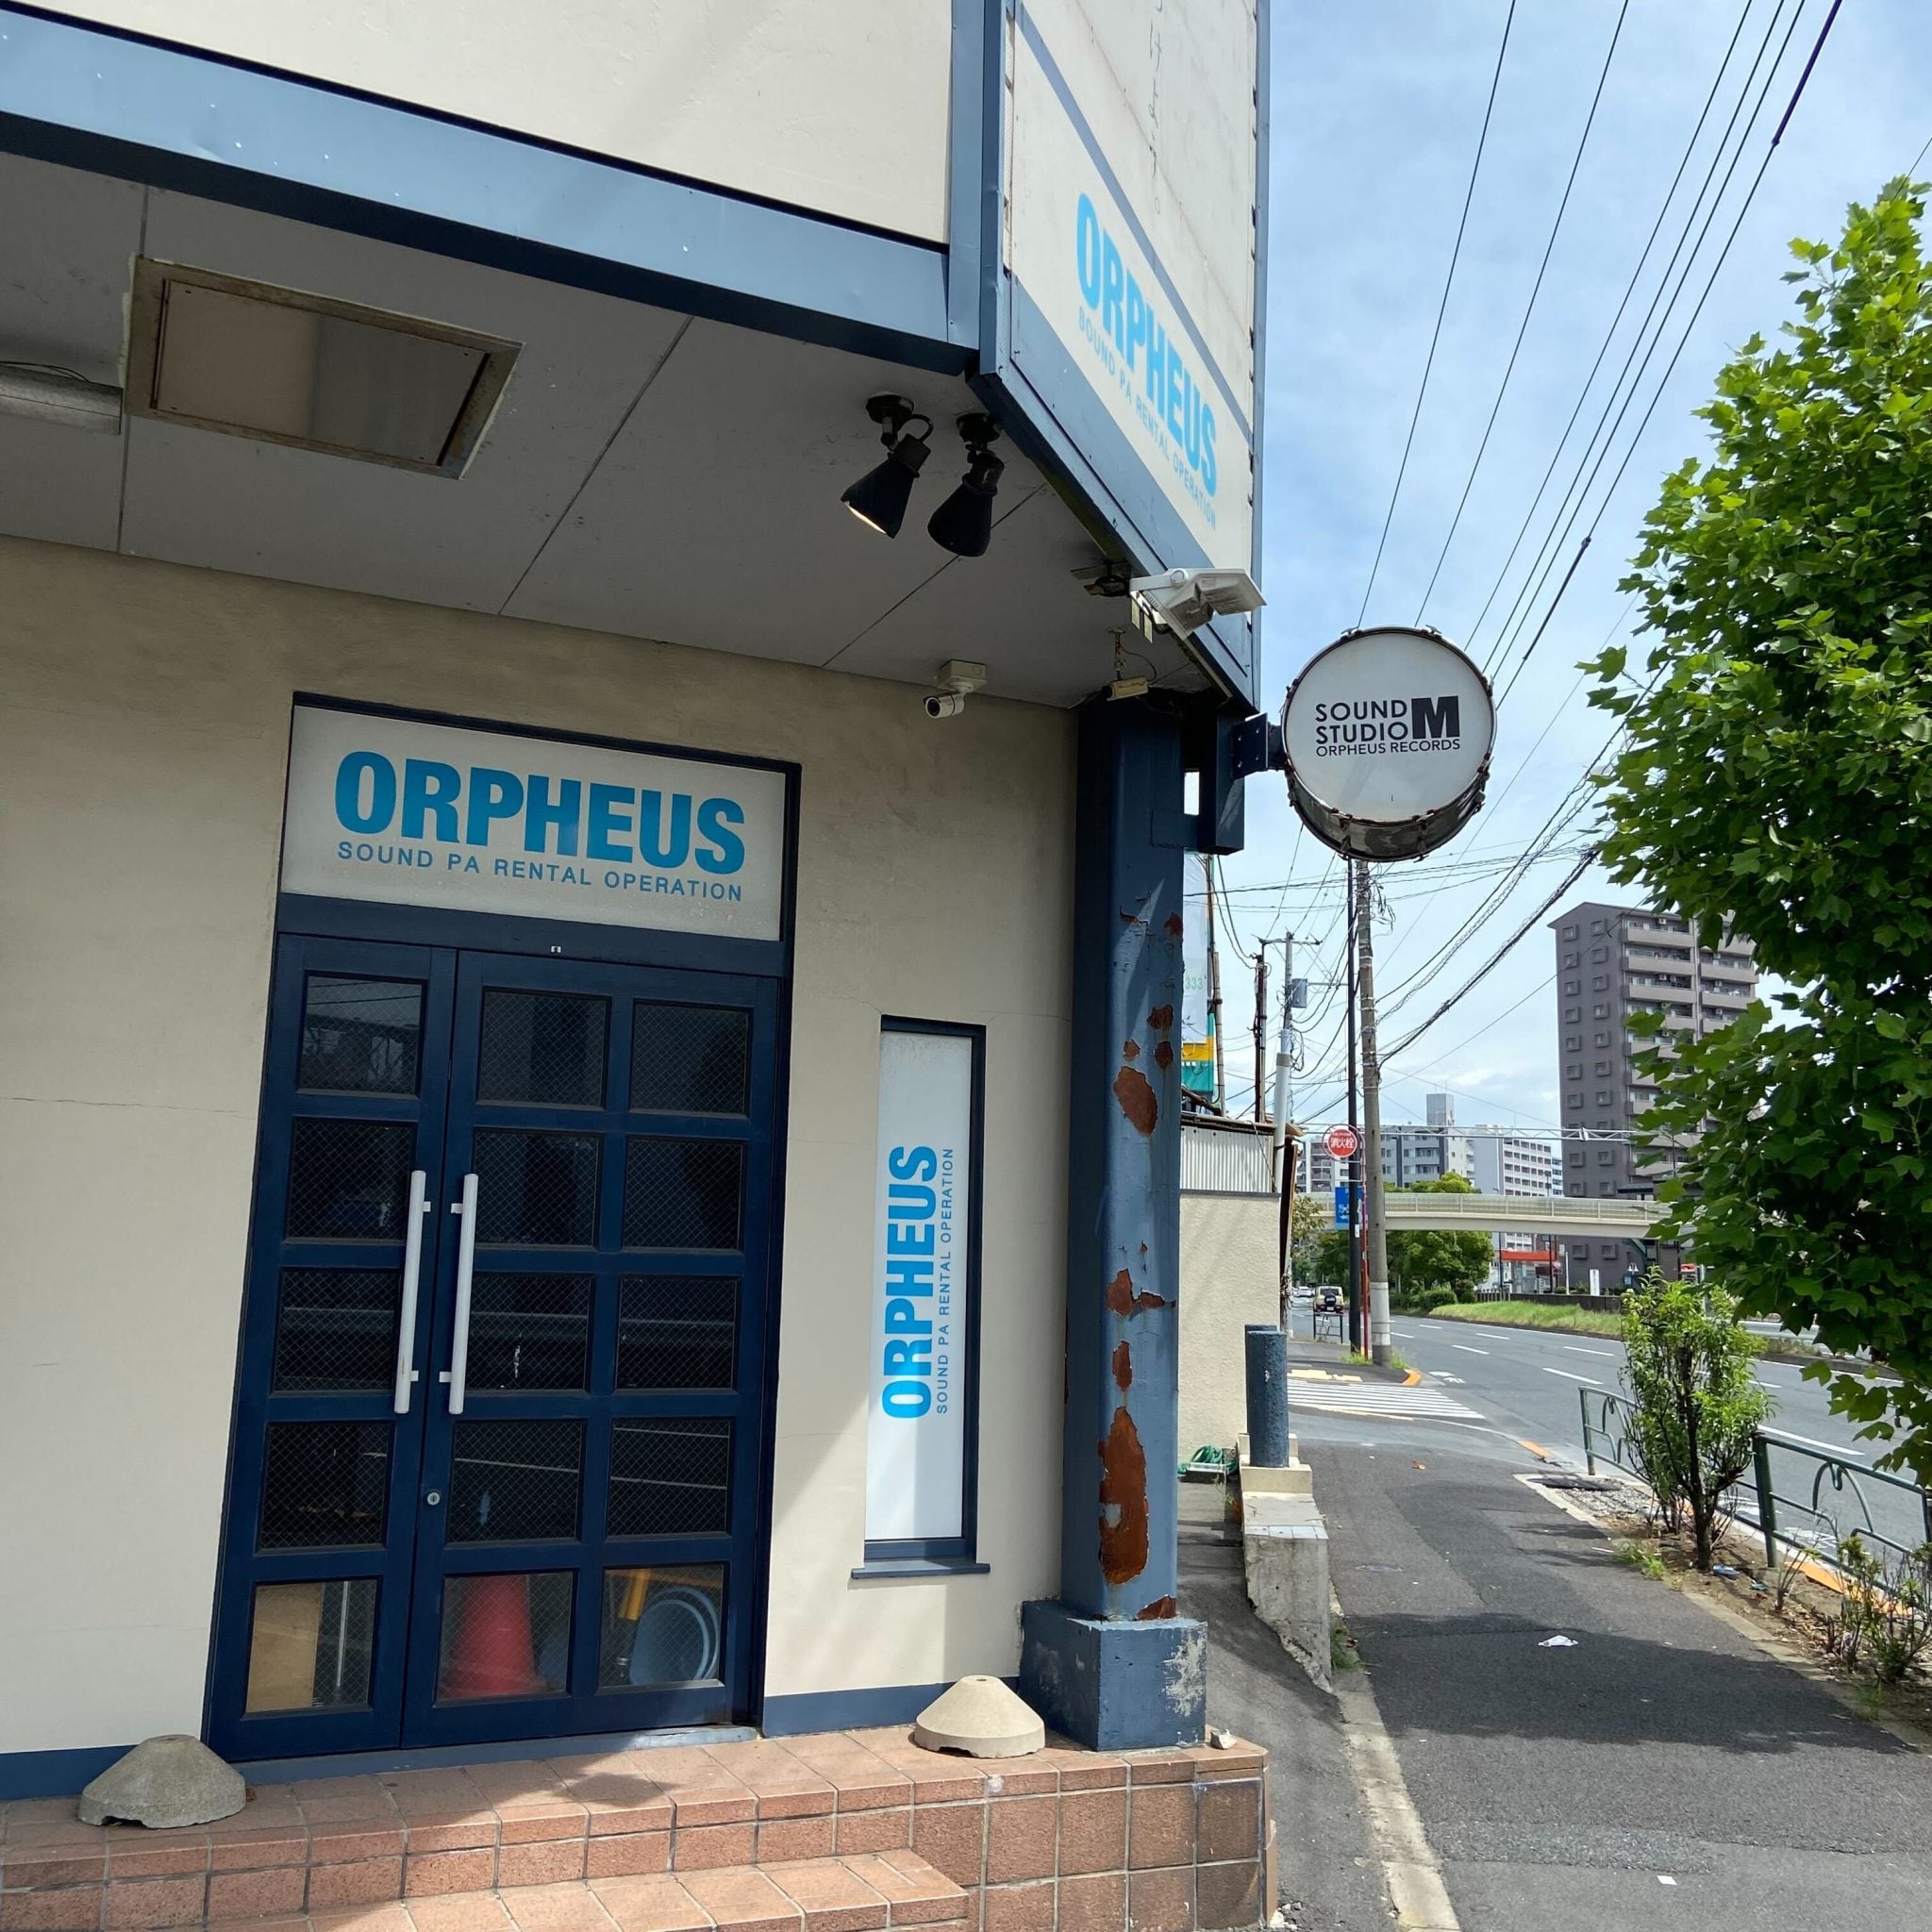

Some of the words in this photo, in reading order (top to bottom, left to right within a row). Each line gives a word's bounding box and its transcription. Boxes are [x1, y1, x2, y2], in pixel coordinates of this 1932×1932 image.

[1076, 192, 1217, 497] ORPHEUS
[1078, 306, 1115, 377] SOUND
[1119, 369, 1132, 405] PA
[1135, 394, 1170, 463] RENTAL
[1173, 457, 1216, 530] OPERATION
[1315, 700, 1407, 722] SOUND
[1316, 722, 1407, 743] STUDIO
[1411, 695, 1459, 739] M
[1316, 743, 1386, 757] ORPHEUS
[1391, 739, 1460, 753] RECORDS
[335, 751, 745, 874] ORPHEUS
[338, 841, 434, 869] SOUND
[447, 854, 480, 874] PA
[493, 858, 592, 887] RENTAL
[604, 871, 742, 903] OPERATION
[1330, 1137, 1355, 1149] 消火栓
[941, 1148, 954, 1243] OPERATION
[882, 1146, 937, 1419] ORPHEUS
[939, 1251, 951, 1316] RENTAL
[938, 1324, 950, 1346] PA
[936, 1354, 949, 1414] SOUND
